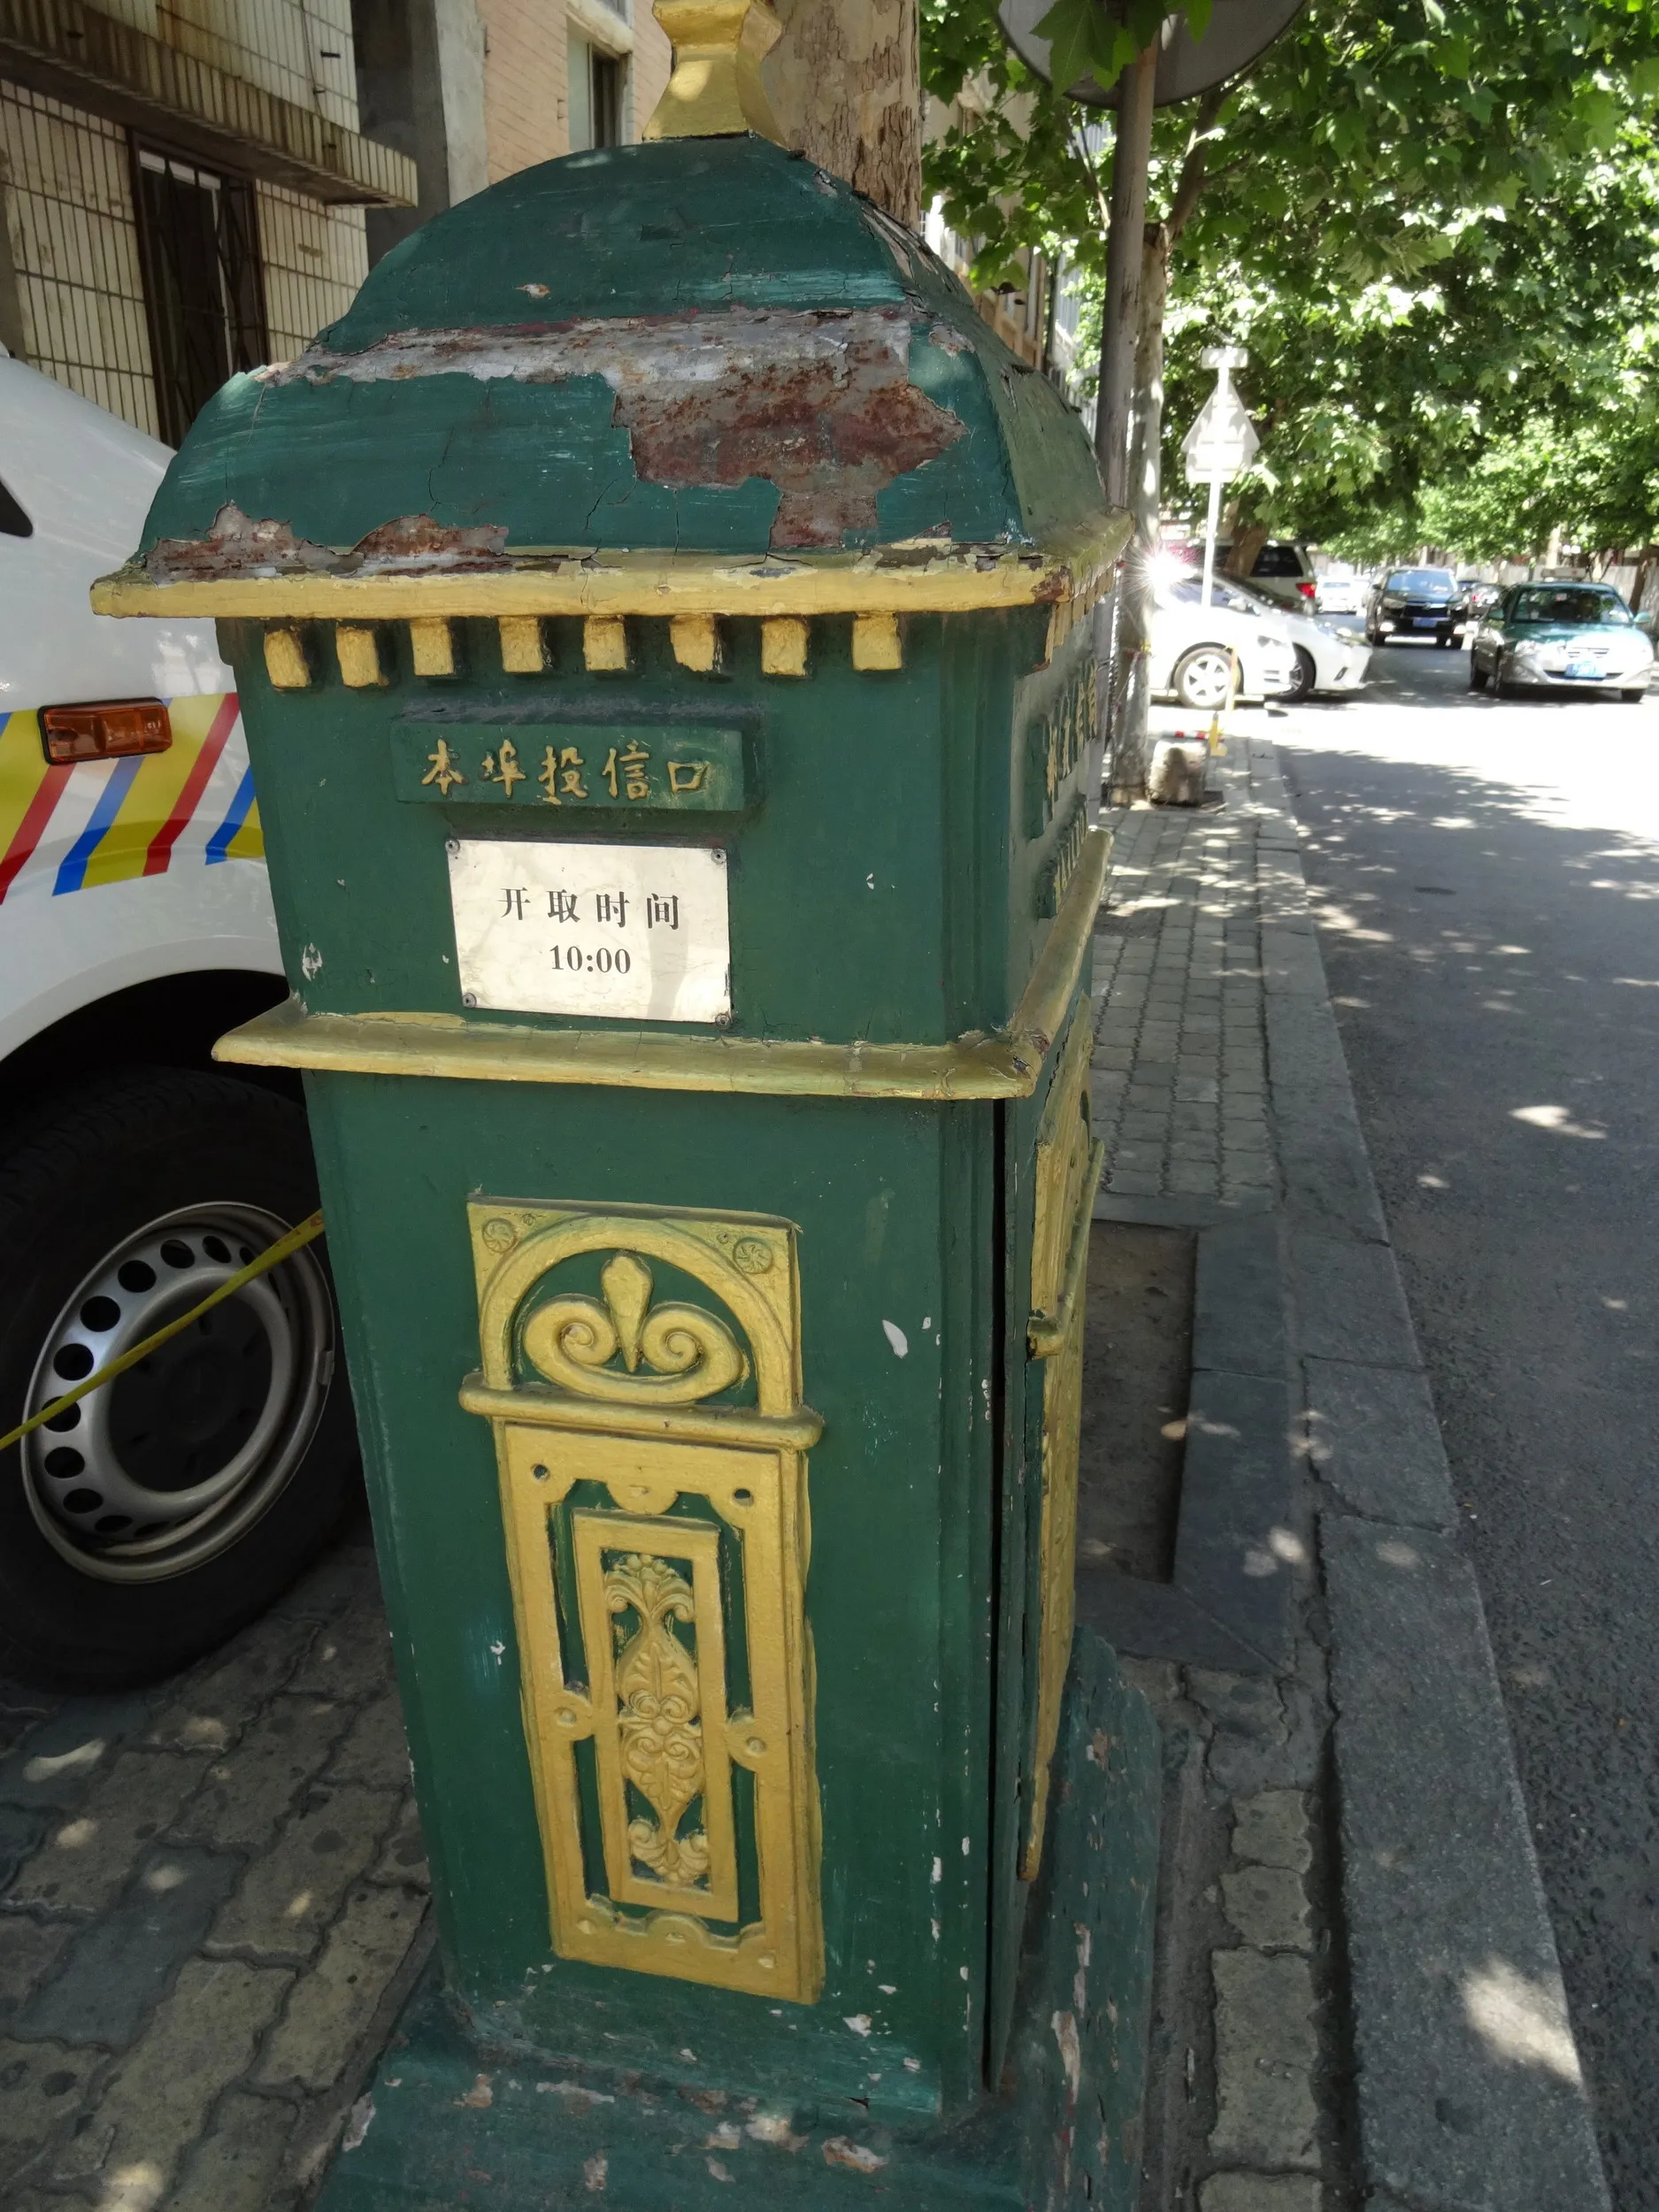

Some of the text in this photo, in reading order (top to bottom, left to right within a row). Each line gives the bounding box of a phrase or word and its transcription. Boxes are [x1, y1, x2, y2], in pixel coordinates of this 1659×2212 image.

[421, 738, 710, 802] 本埠投信口
[497, 887, 680, 931] 开取时间
[549, 944, 632, 974] 10:00
